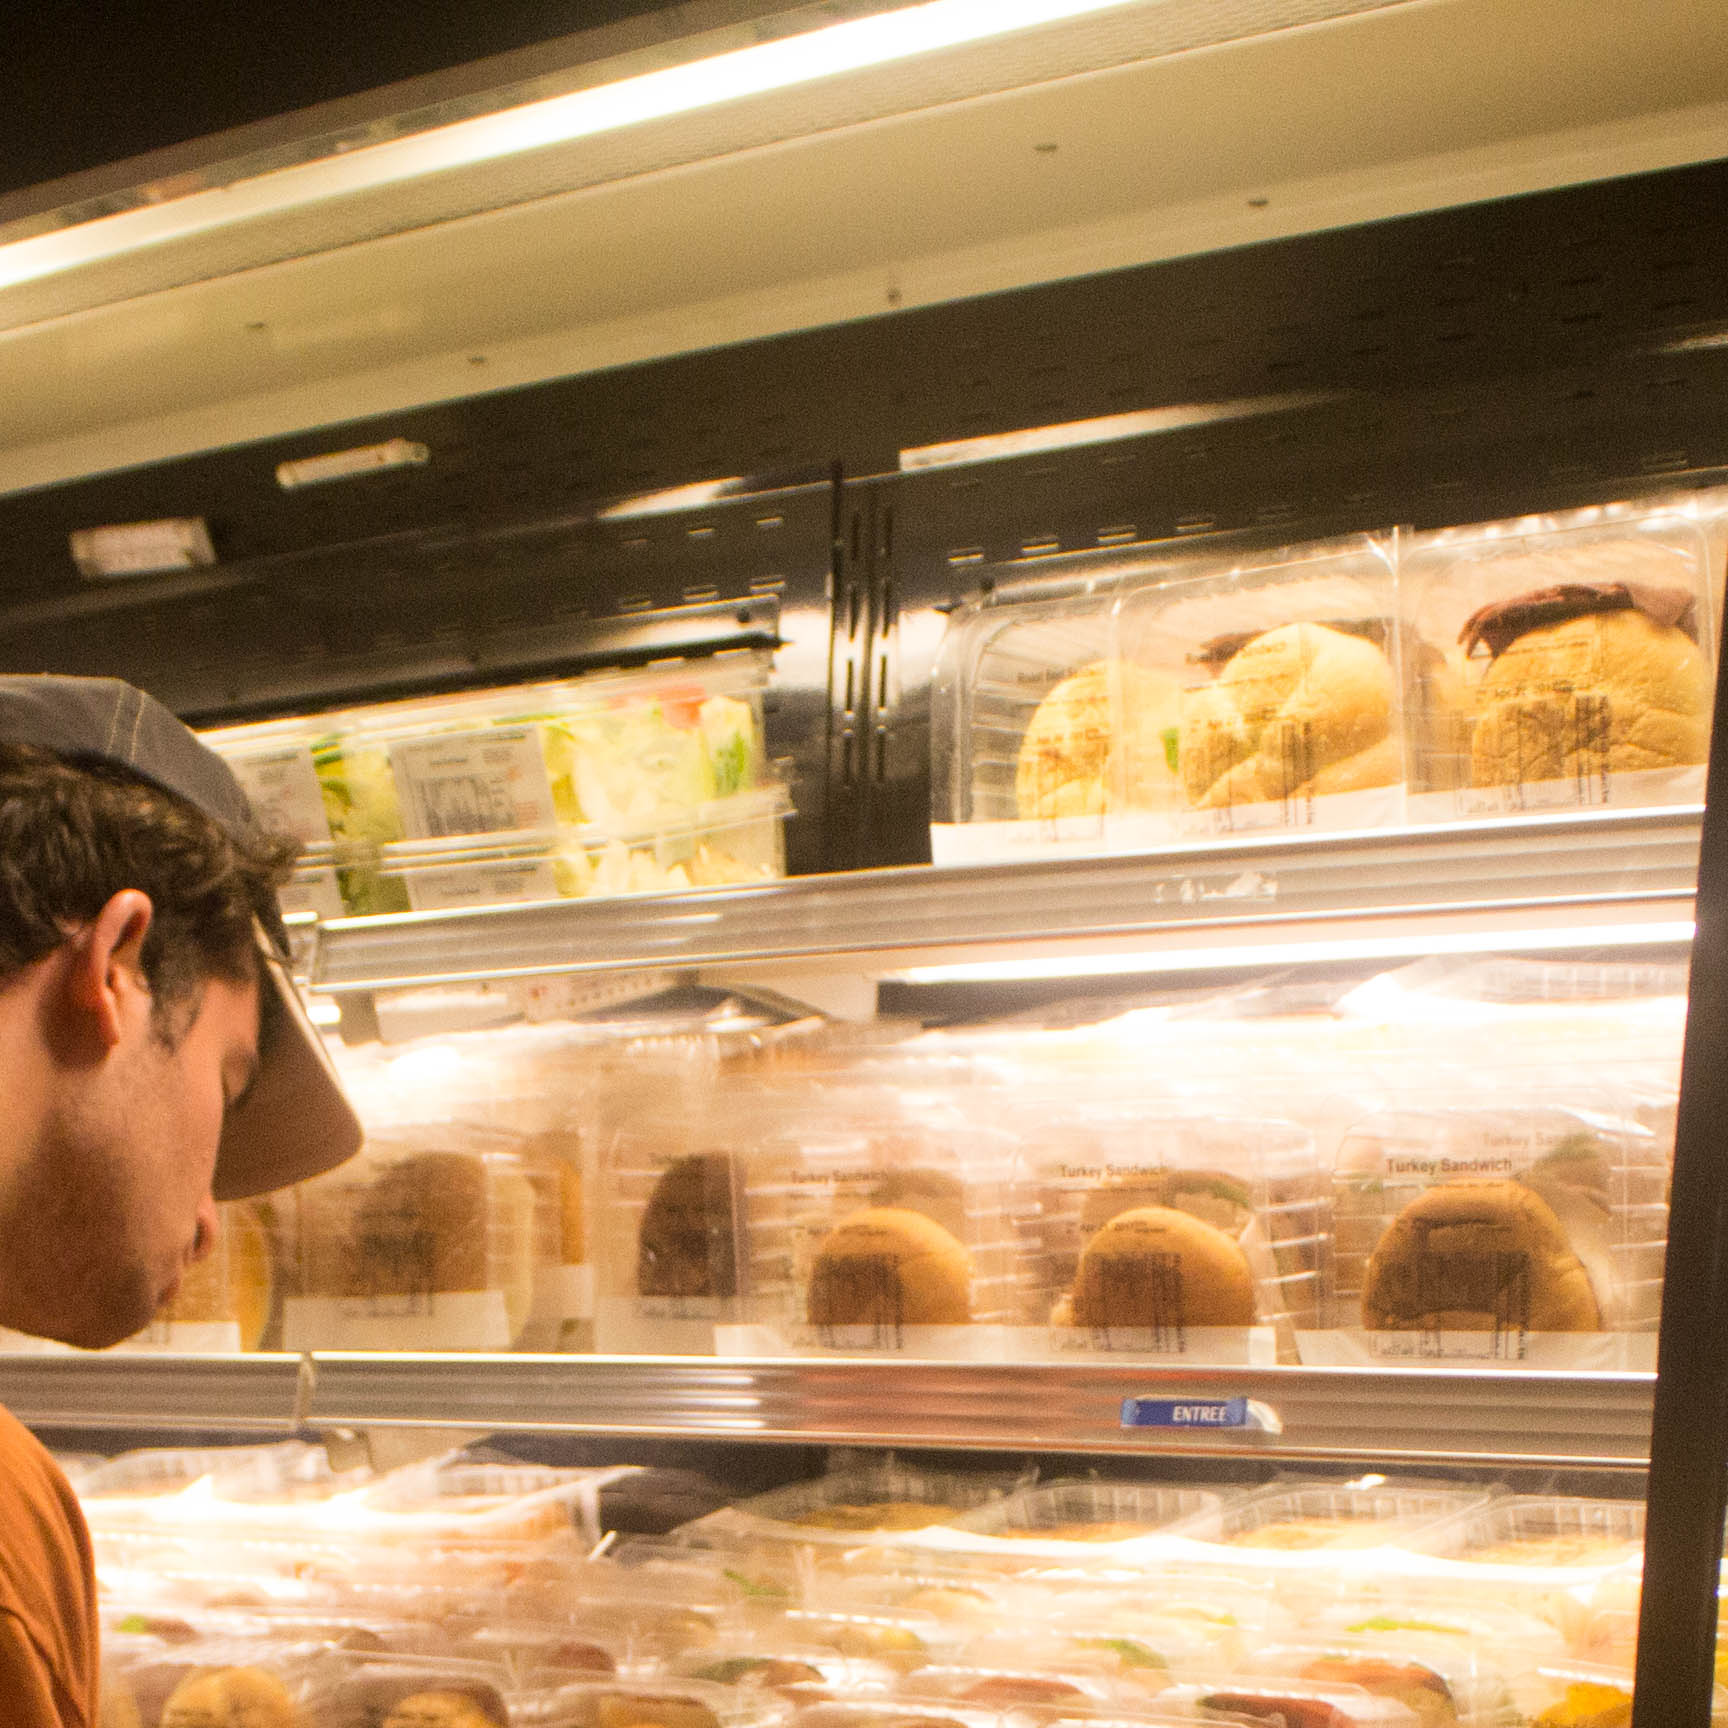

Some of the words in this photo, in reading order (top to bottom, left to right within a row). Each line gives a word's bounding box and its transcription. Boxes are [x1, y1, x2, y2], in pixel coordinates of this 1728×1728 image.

[1059, 1164, 1103, 1181] Turkey
[1385, 1158, 1436, 1176] Turkey
[1440, 1157, 1513, 1173] Sandwich
[1173, 1405, 1227, 1422] ENTREE
